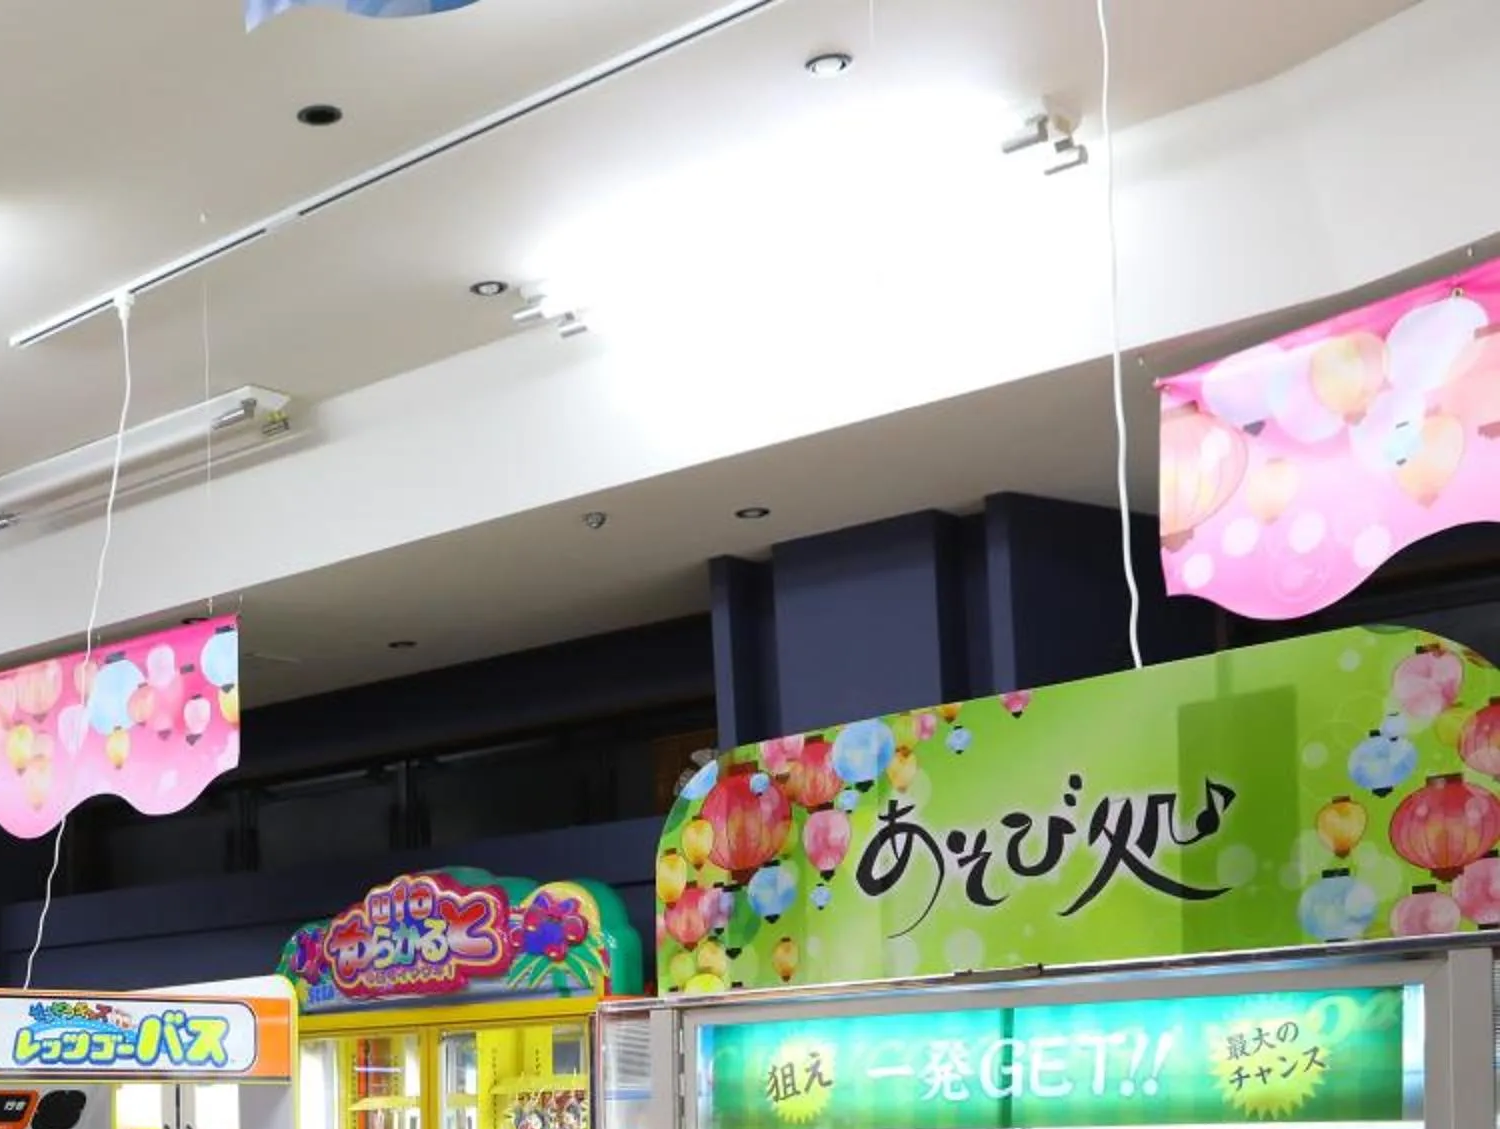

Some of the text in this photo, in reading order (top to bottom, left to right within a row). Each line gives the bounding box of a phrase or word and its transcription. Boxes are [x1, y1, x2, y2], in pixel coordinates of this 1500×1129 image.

[856, 774, 1236, 938] あそび処
[13, 1010, 231, 1067] レッツゴーバス
[866, 1025, 1172, 1102] 一発GET!!
[1226, 1020, 1299, 1060] 最大の
[766, 1050, 834, 1102] 狙え
[1229, 1045, 1327, 1090] チャンス
